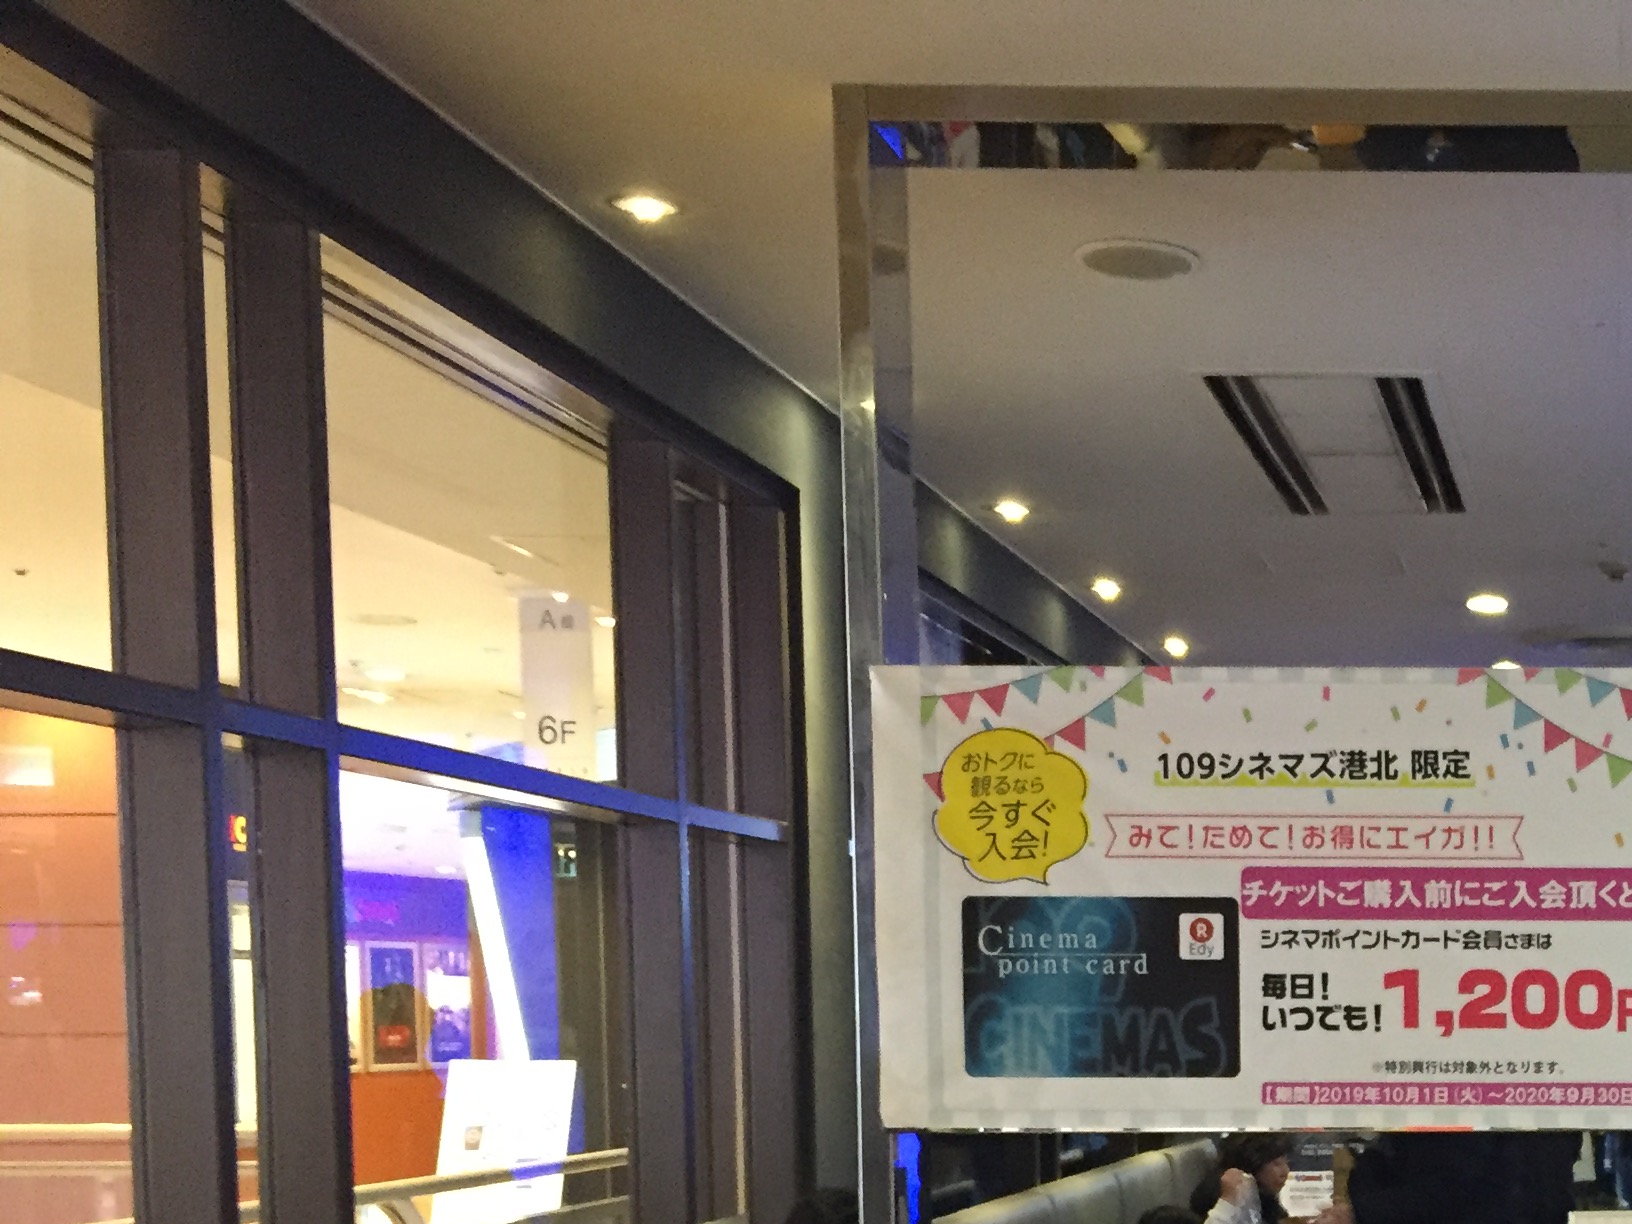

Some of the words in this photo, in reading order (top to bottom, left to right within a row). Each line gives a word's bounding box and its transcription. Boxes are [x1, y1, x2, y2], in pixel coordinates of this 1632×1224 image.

[537, 714, 577, 745] 6F
[960, 751, 1035, 773] おトクに
[1158, 751, 1399, 780] 109シネマズ港北
[1410, 749, 1472, 780] 限定
[970, 776, 1045, 797] 観るなら
[968, 800, 1057, 830] 今すぐ
[978, 829, 1050, 863] 入会!
[977, 924, 1098, 957] Cinema
[1260, 929, 1553, 951] シネマポイントカード会員さまは
[998, 953, 1071, 979] point
[1085, 953, 1149, 976] card
[1261, 972, 1330, 1001] 毎日!
[1261, 1003, 1382, 1033] いつでも!
